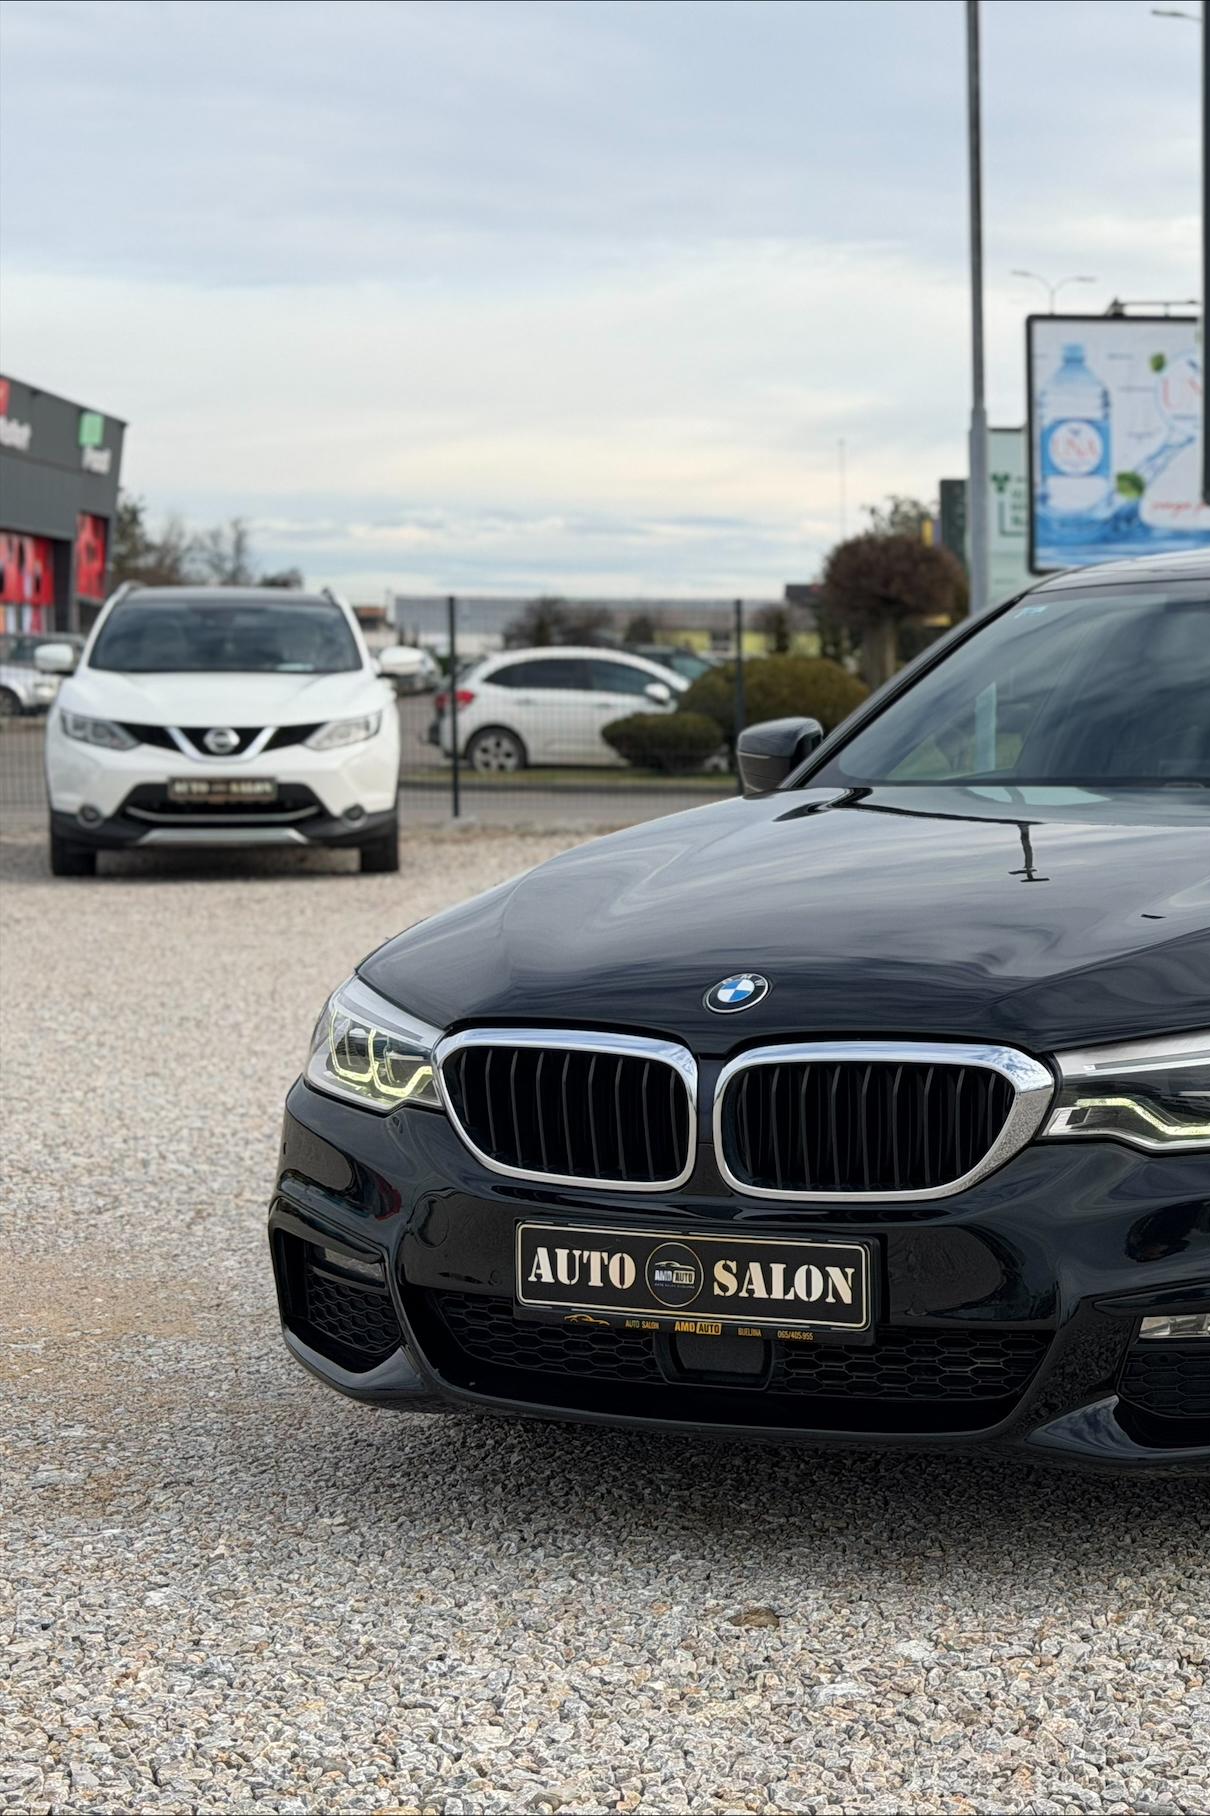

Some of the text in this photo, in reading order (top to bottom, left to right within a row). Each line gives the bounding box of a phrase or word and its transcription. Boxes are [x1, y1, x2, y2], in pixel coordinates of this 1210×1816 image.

[528, 1247, 855, 1305] AUTO SALON
[625, 1319, 640, 1329] AUTO
[641, 1321, 660, 1330] SALON
[674, 1321, 695, 1333] AMD
[699, 1323, 720, 1335] AUTO
